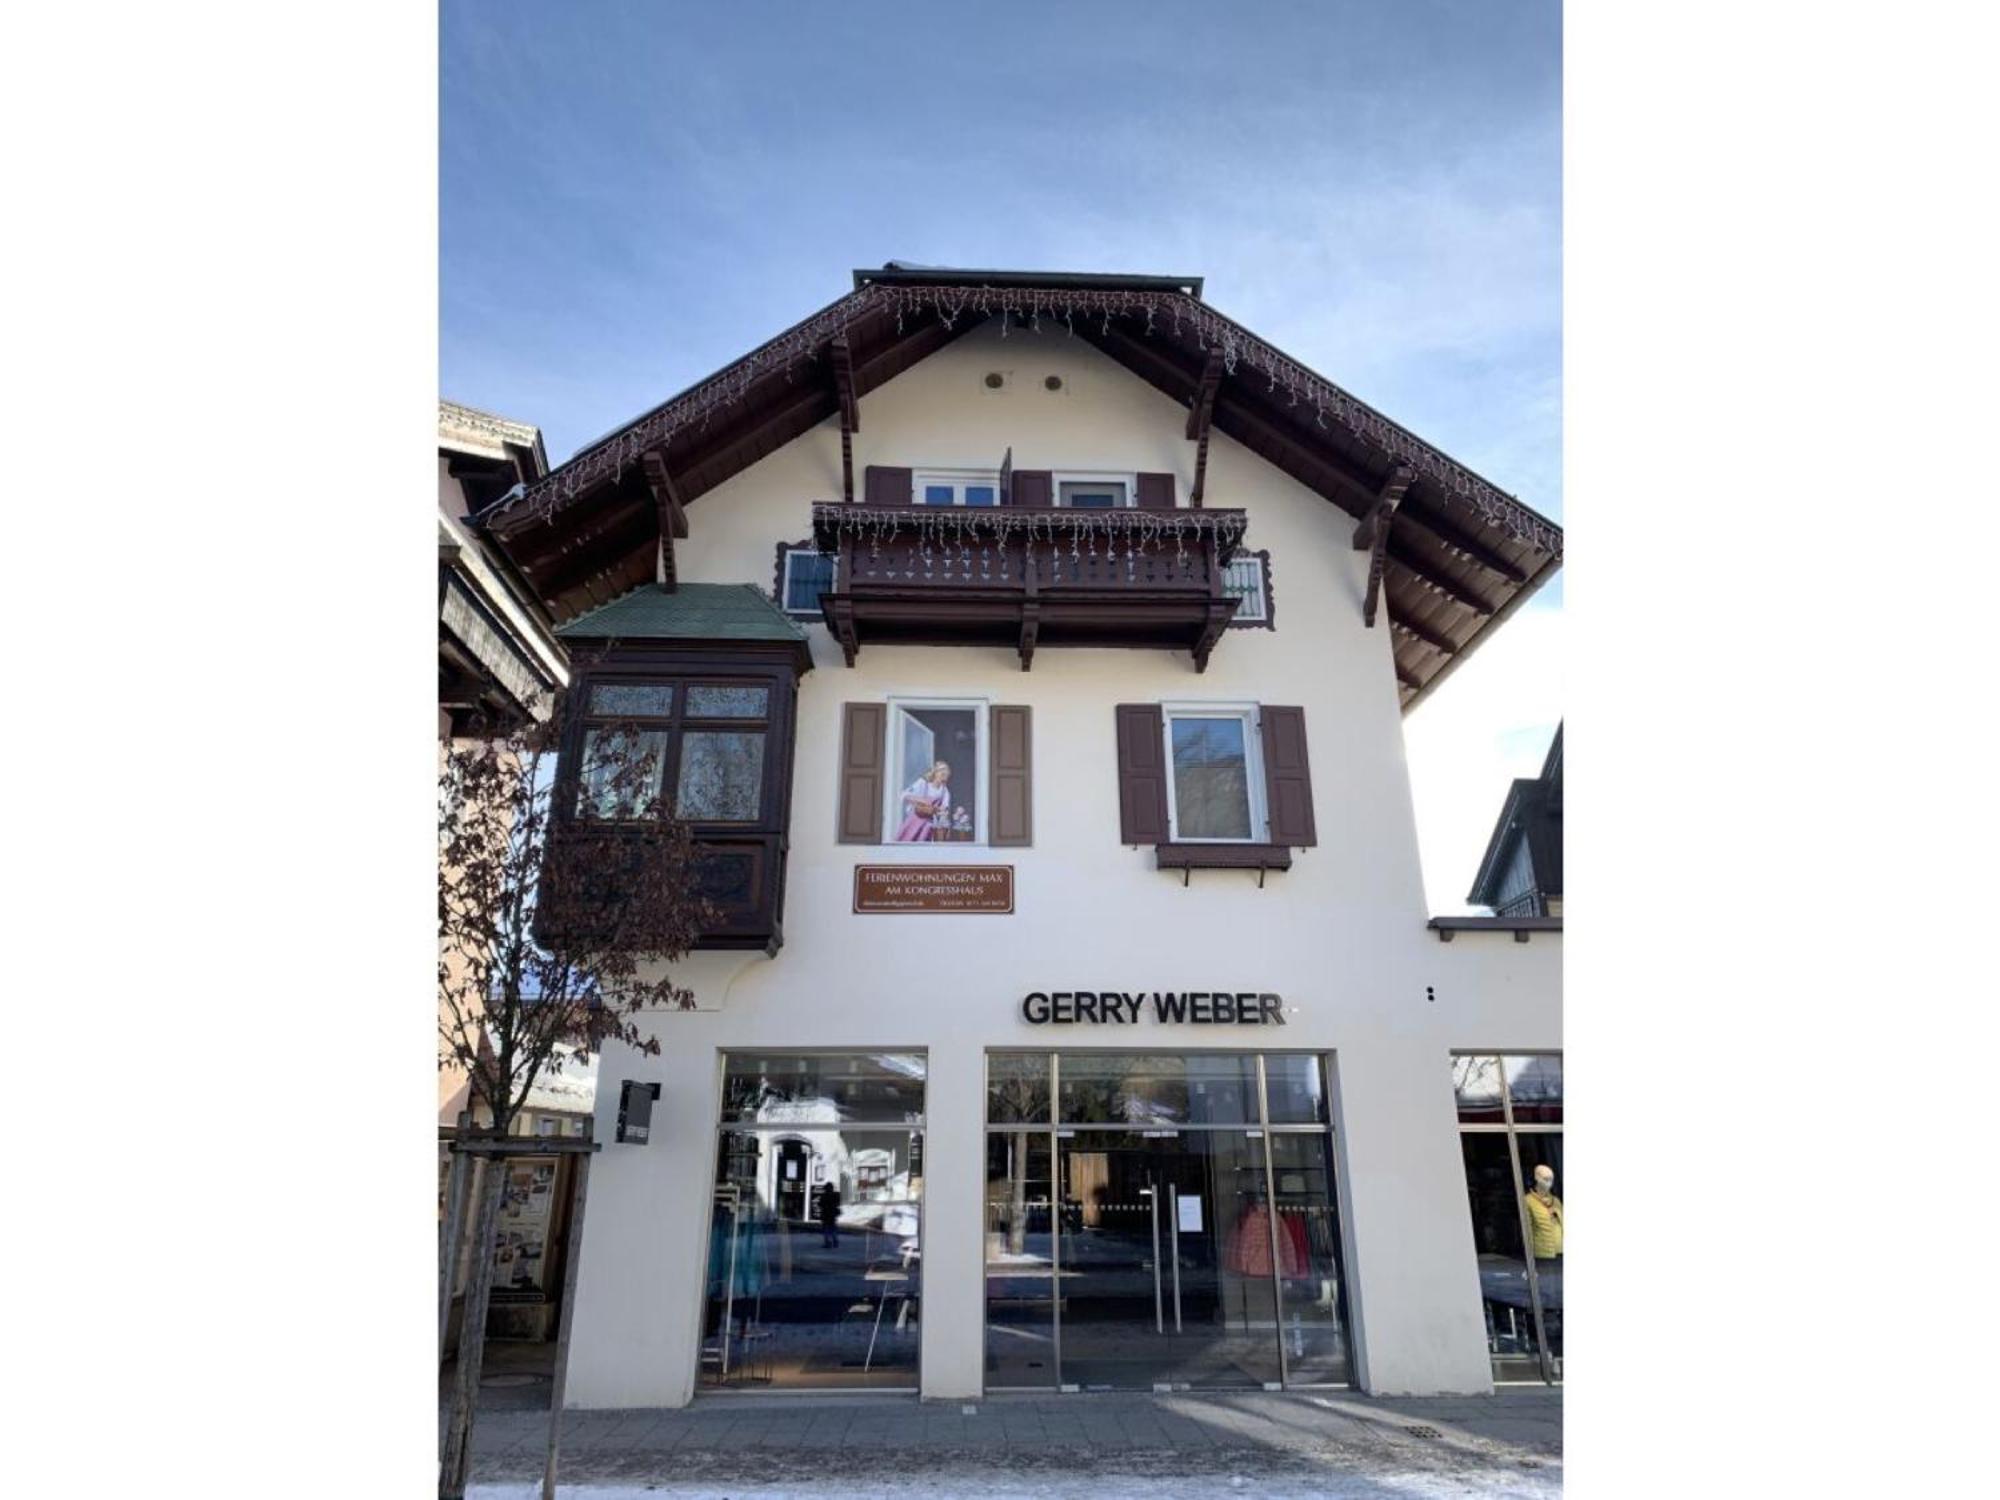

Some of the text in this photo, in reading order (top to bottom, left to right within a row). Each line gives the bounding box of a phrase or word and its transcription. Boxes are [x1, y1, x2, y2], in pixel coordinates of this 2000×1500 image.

[865, 872, 1003, 883] FERIENWOHNUNGEN MAX
[884, 886, 984, 895] AM KONGRESSHAUS
[1022, 991, 1286, 1025] GERRY WEBER
